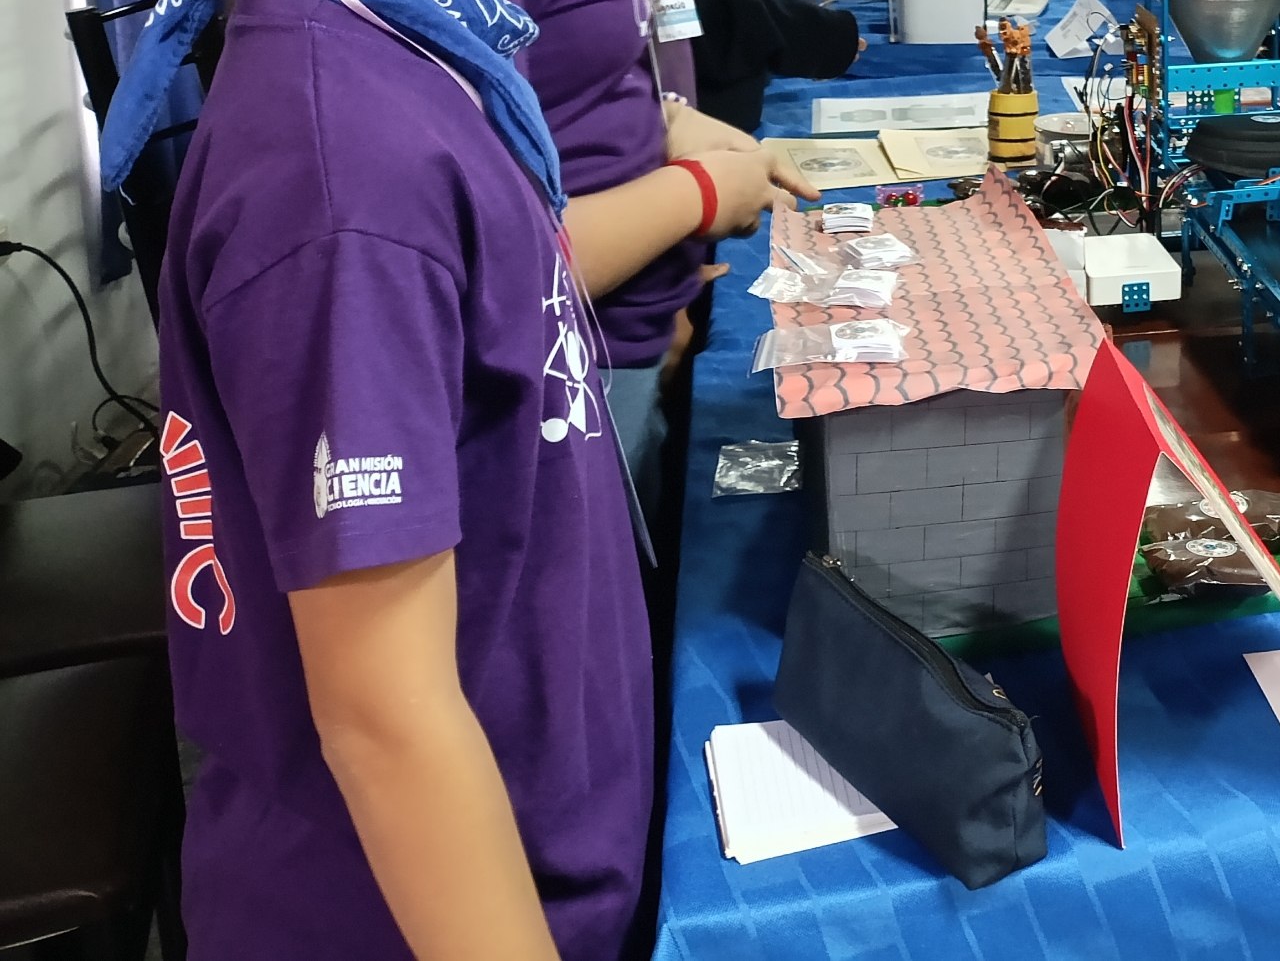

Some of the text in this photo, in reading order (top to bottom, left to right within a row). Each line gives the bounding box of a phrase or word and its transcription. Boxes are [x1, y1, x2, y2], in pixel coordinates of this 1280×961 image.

[325, 454, 402, 478] GRAN MISIÓN
[326, 472, 401, 502] CIENCIA
